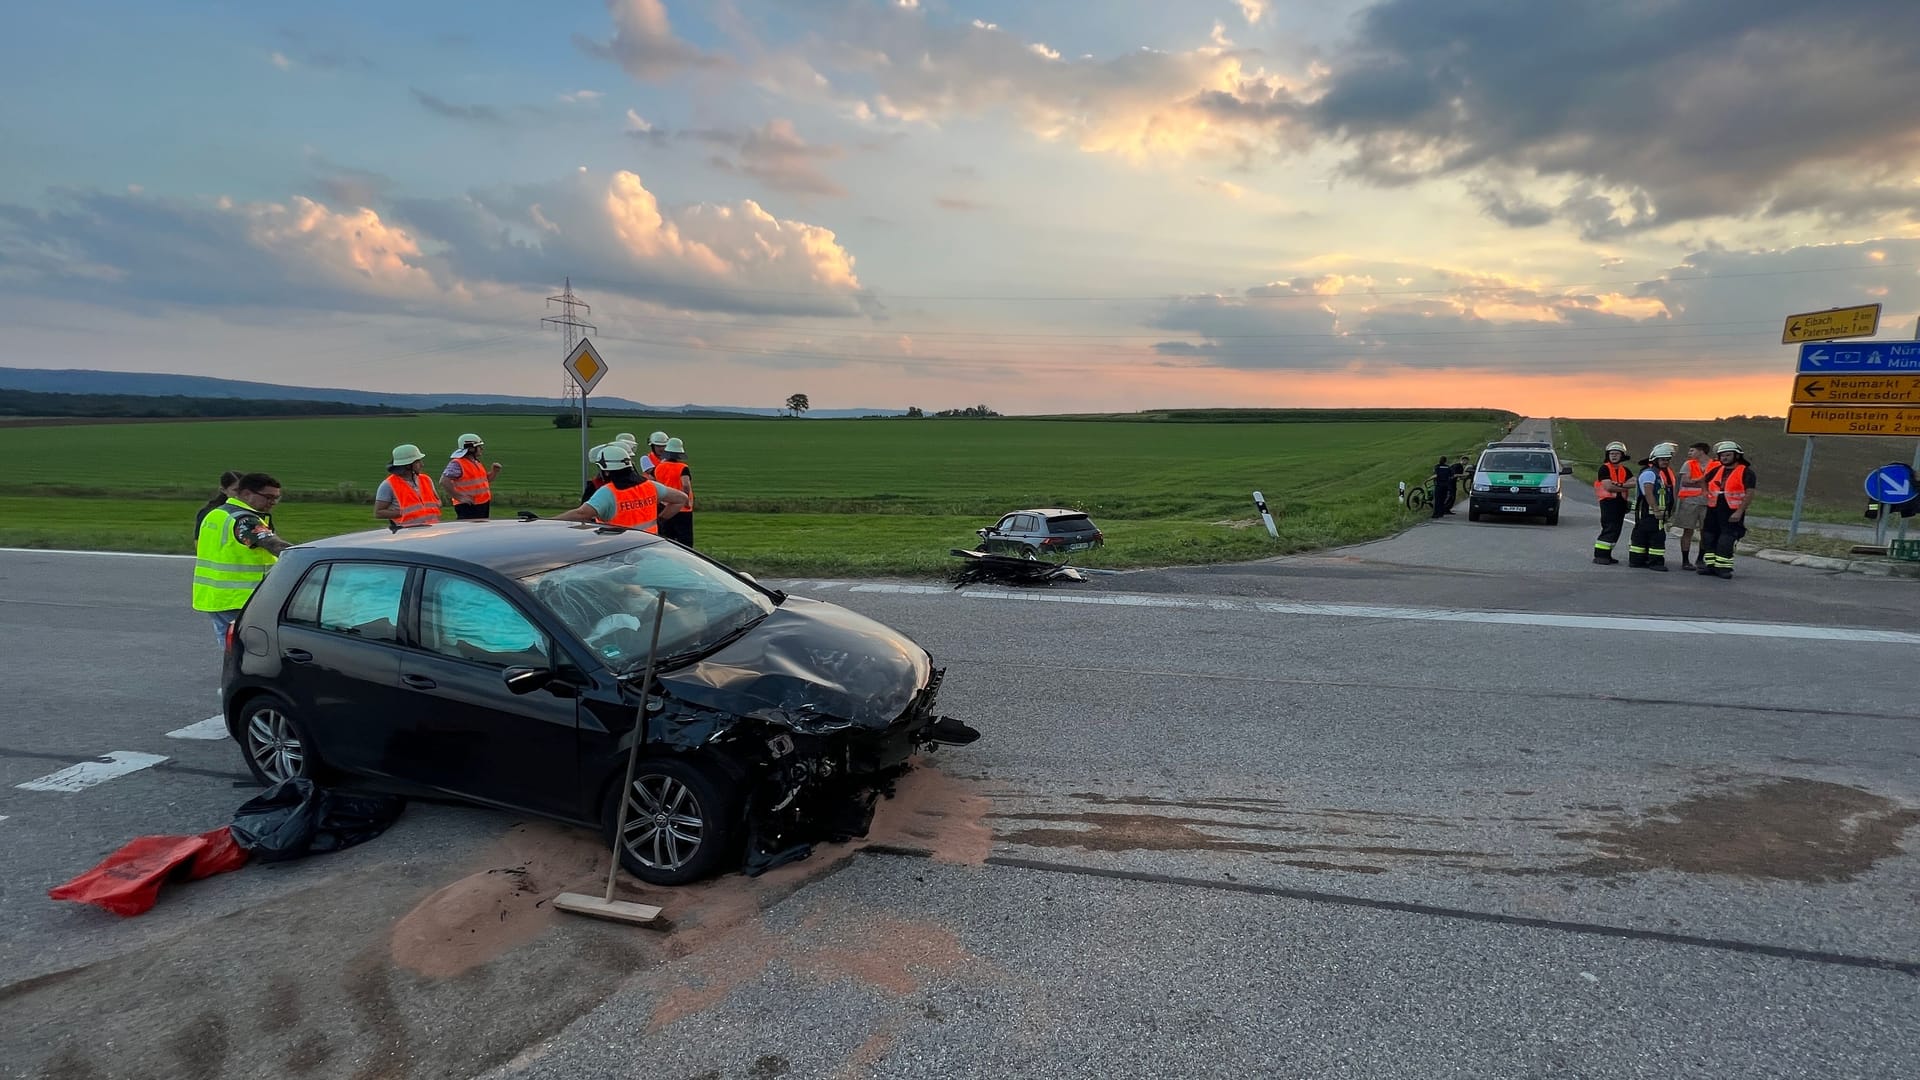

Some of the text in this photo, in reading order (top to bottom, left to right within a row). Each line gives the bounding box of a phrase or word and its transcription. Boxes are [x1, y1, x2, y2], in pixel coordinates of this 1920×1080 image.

[1805, 316, 1832, 327] Eibach
[1853, 312, 1860, 321] 2
[1803, 324, 1848, 336] Patersholz
[1830, 379, 1899, 389] Neumarkt
[1829, 390, 1912, 400] Sindersdorf
[1810, 410, 1889, 421] Hilpoltstein
[1895, 410, 1903, 420] 4
[1849, 422, 1885, 431] Solar
[1894, 423, 1902, 432] 2
